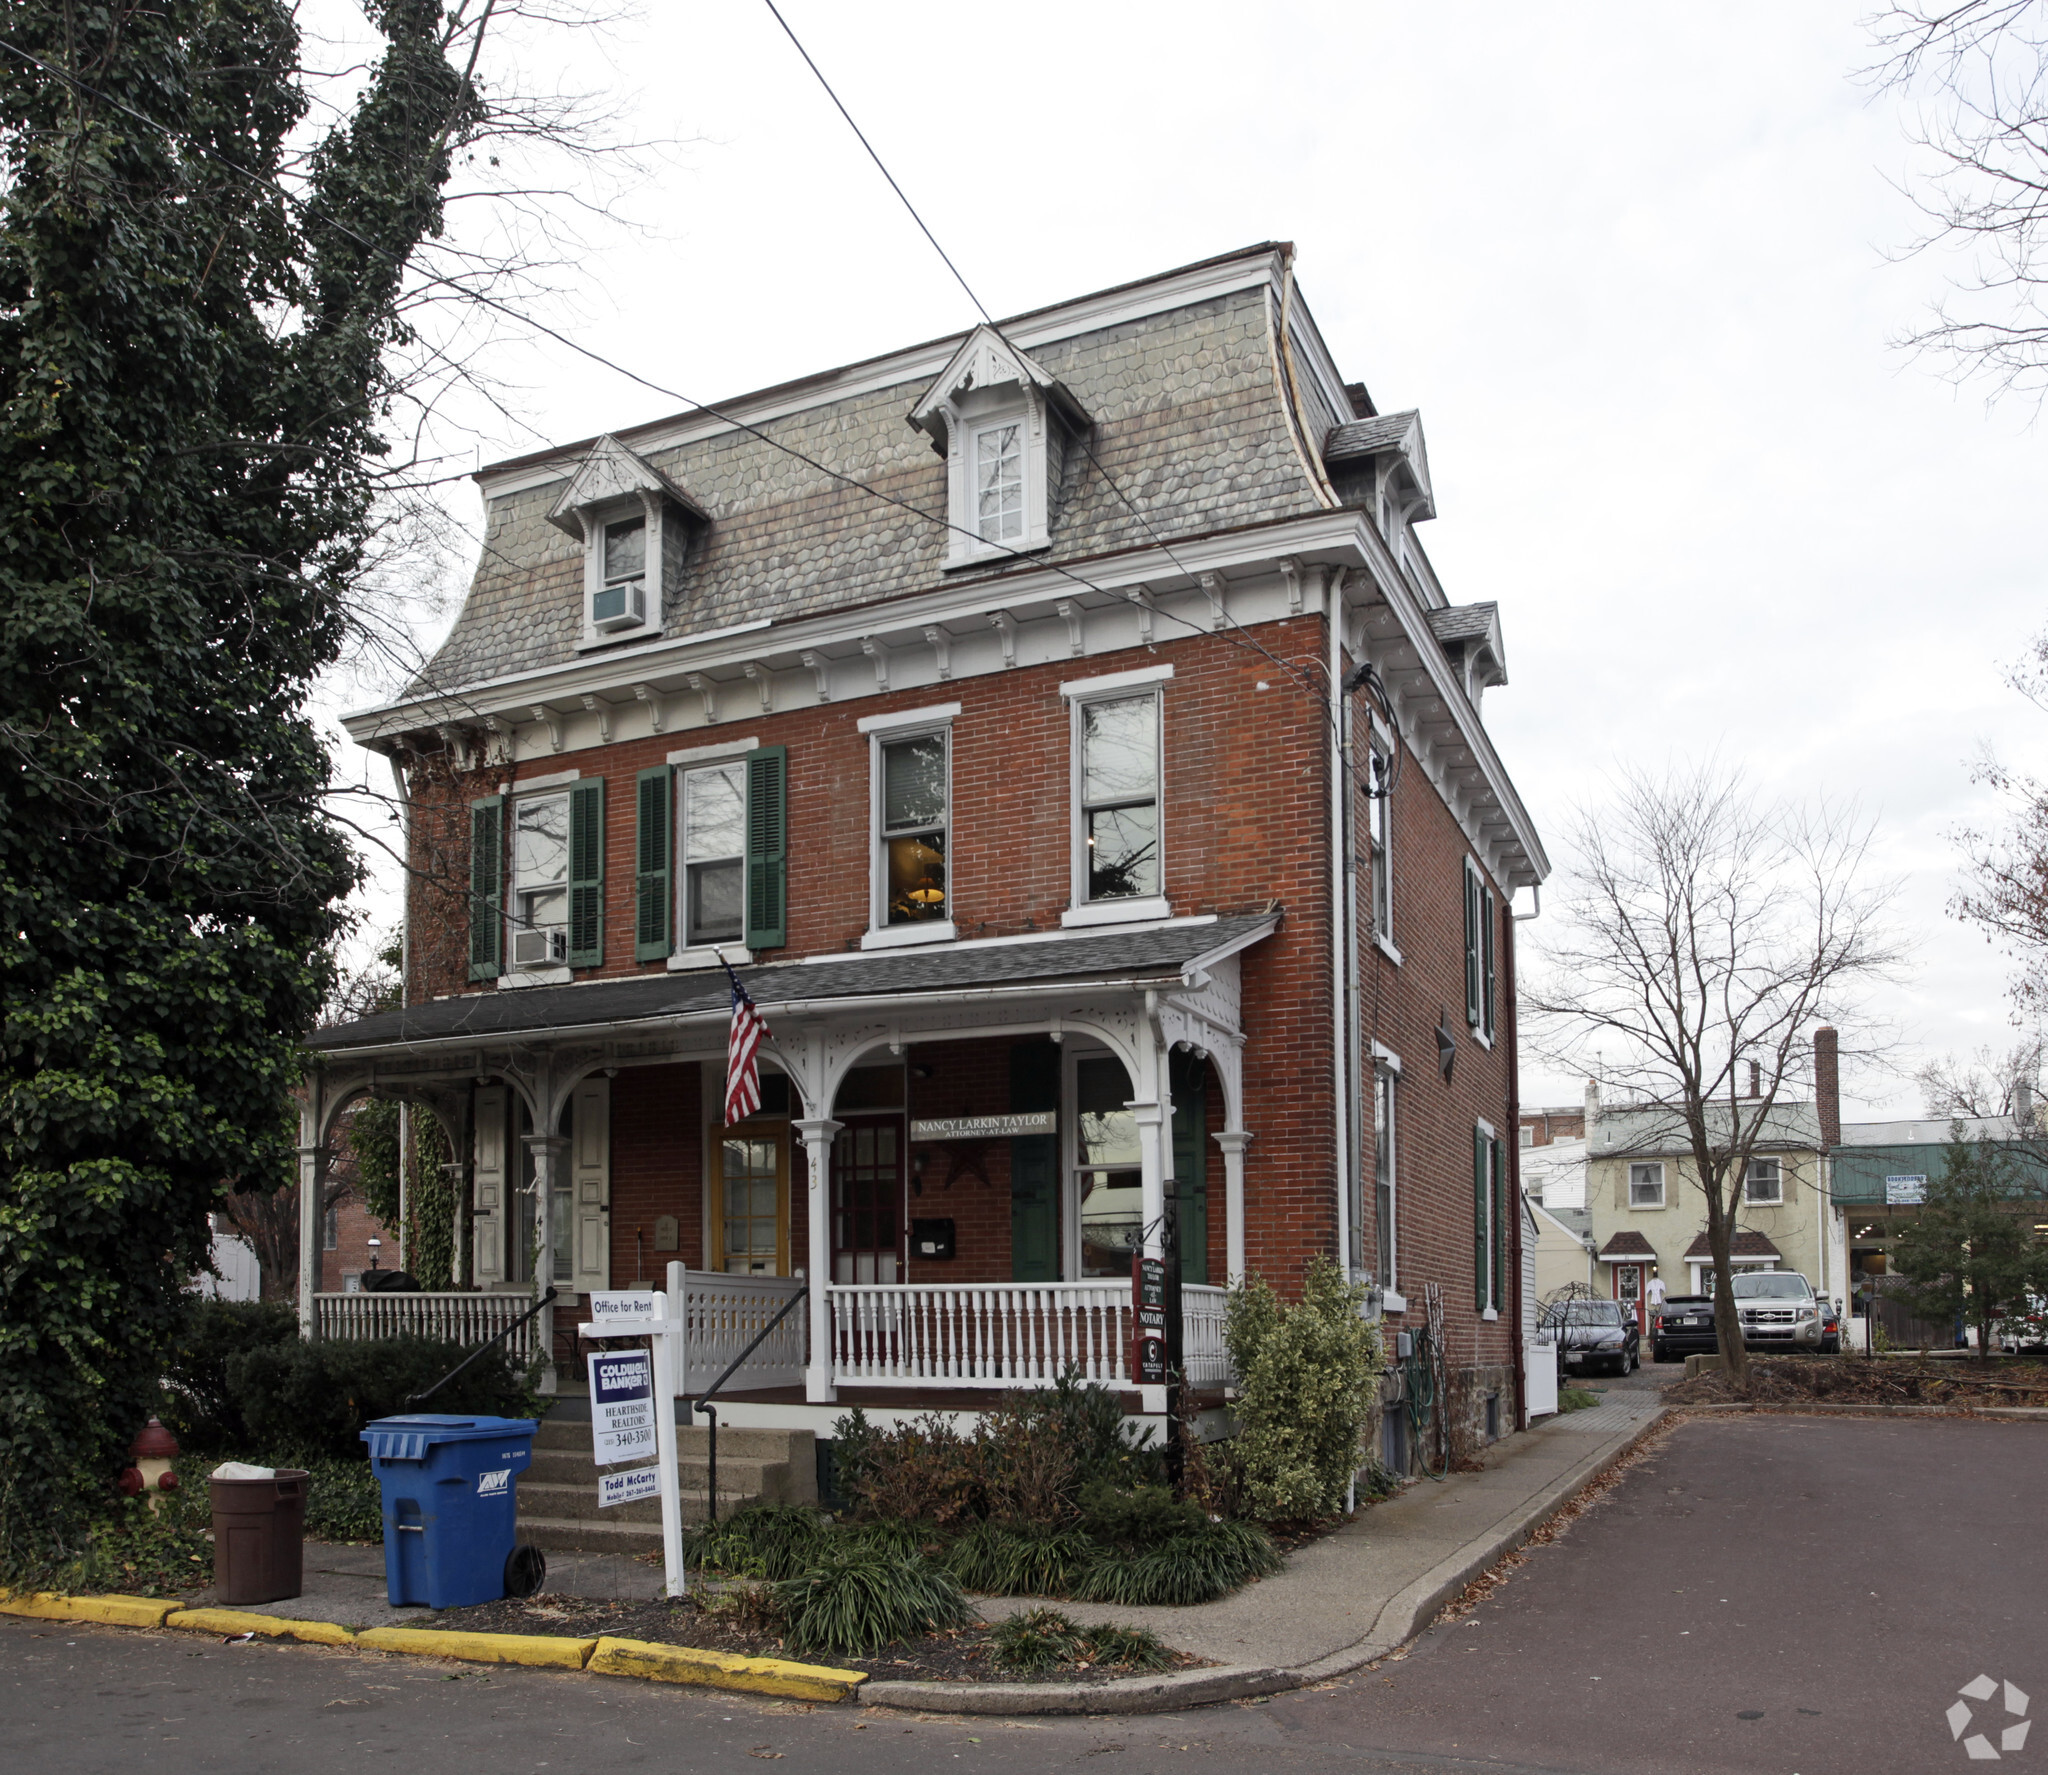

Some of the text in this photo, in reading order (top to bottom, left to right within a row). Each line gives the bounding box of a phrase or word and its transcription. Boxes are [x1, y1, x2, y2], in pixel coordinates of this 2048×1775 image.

[918, 1114, 1047, 1132] NANCY LARKIN TAYLOR
[945, 1127, 1020, 1138] ATTORNEY-AT-LAW
[810, 1156, 817, 1190] 43
[594, 1300, 652, 1313] Office for Rent
[1139, 1311, 1164, 1325] NOTARY
[605, 1403, 648, 1417] HEARTHSIDE
[612, 1415, 646, 1429] REALTORS
[616, 1428, 651, 1446] 340-3500
[605, 1473, 656, 1491] Todd McCarty
